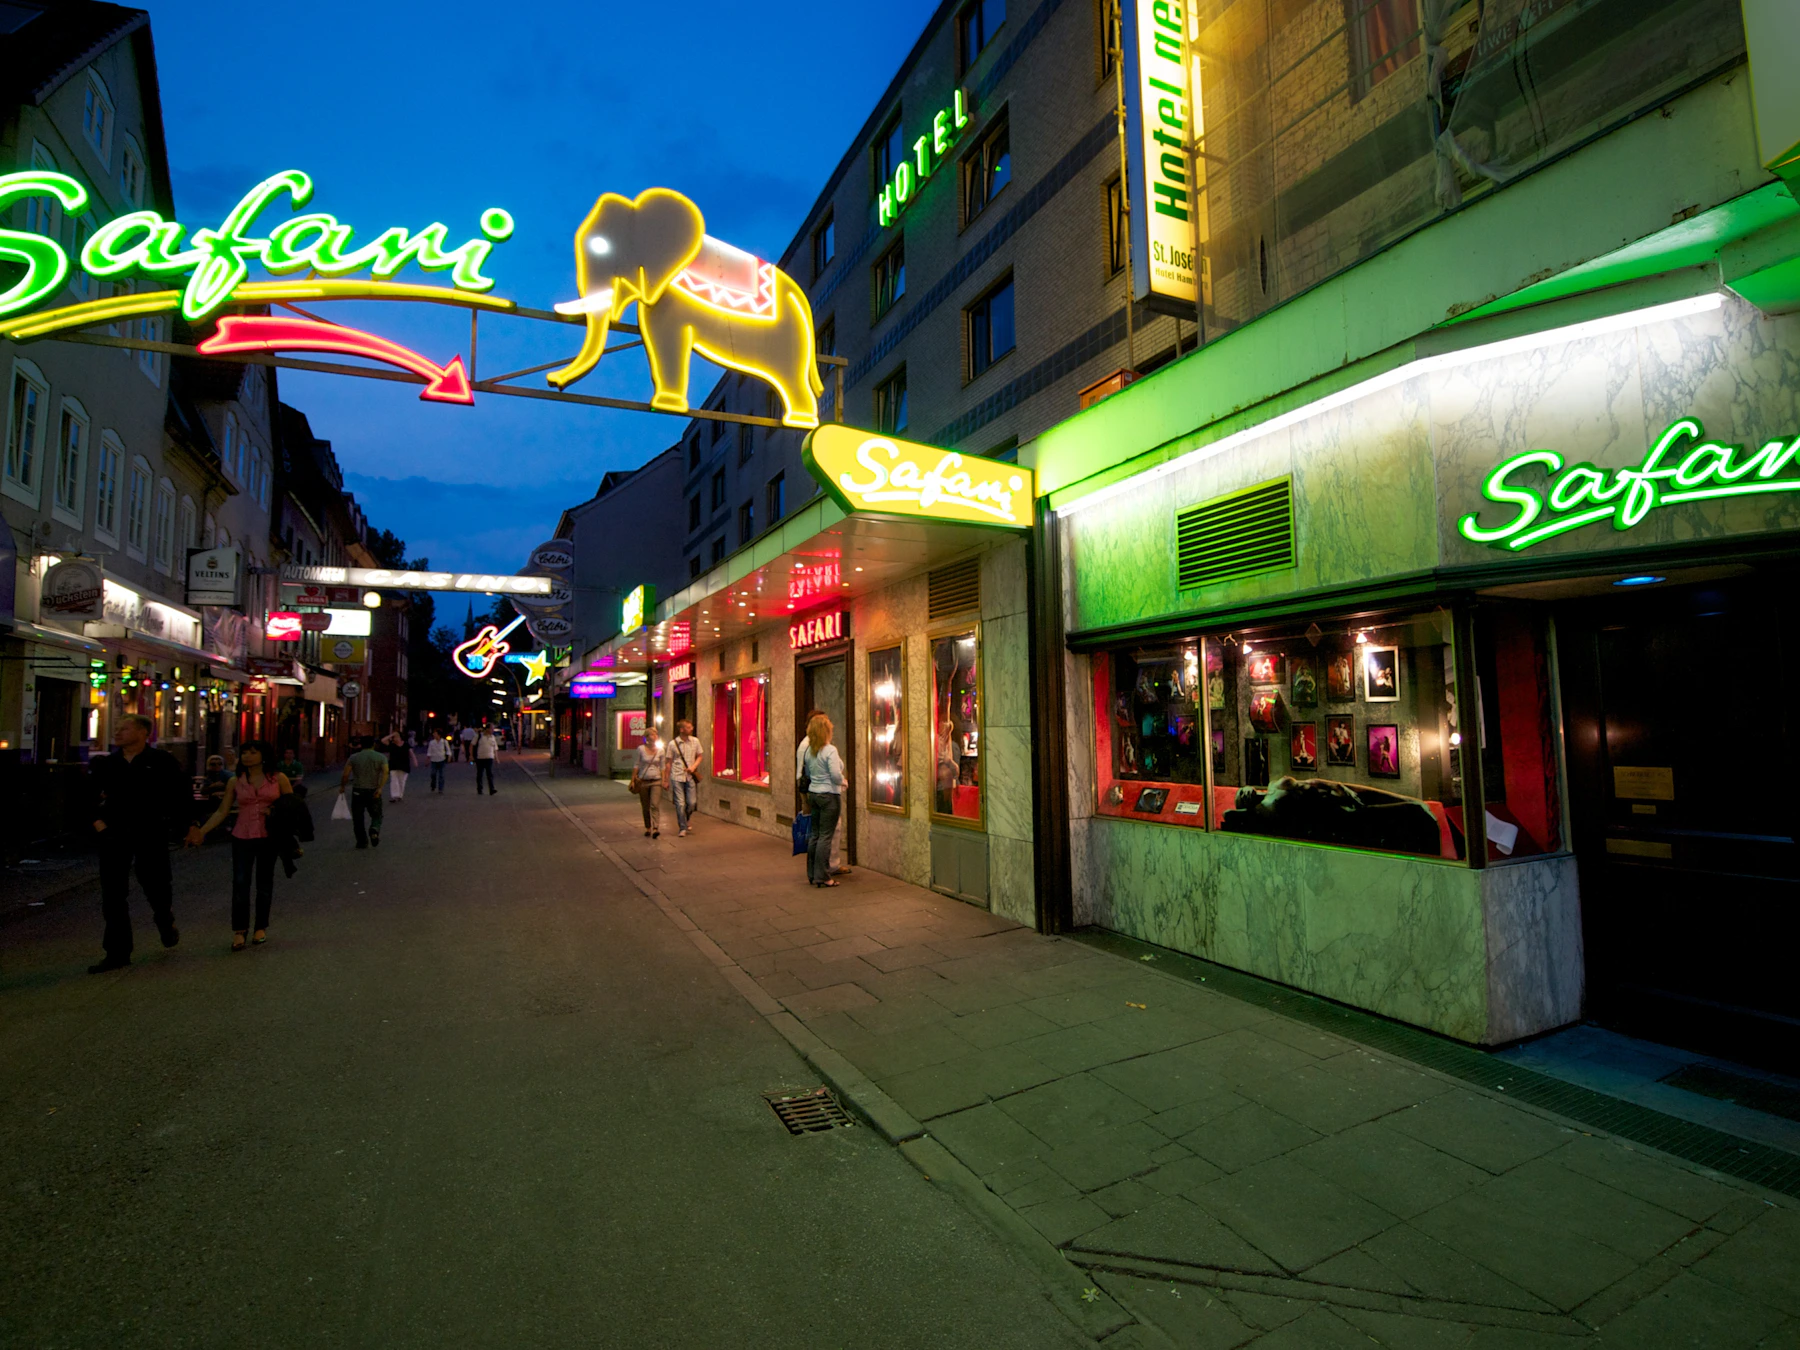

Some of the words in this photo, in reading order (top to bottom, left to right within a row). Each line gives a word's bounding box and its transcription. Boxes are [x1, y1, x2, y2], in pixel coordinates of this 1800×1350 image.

[878, 88, 971, 227] HOTEL
[1149, 76, 1193, 223] Hotel
[1153, 240, 1168, 264] St.
[1155, 267, 1175, 280] Hotel
[839, 437, 1023, 513] Safari
[538, 552, 570, 565] Colibri
[195, 570, 230, 579] VELTINS
[284, 565, 346, 582] AUTOMATEN
[364, 569, 538, 592] CASINO
[298, 596, 326, 604] ASTRA
[536, 619, 568, 632] Colibri
[788, 611, 842, 650] SAFARI
[668, 662, 691, 683] SAFARI
